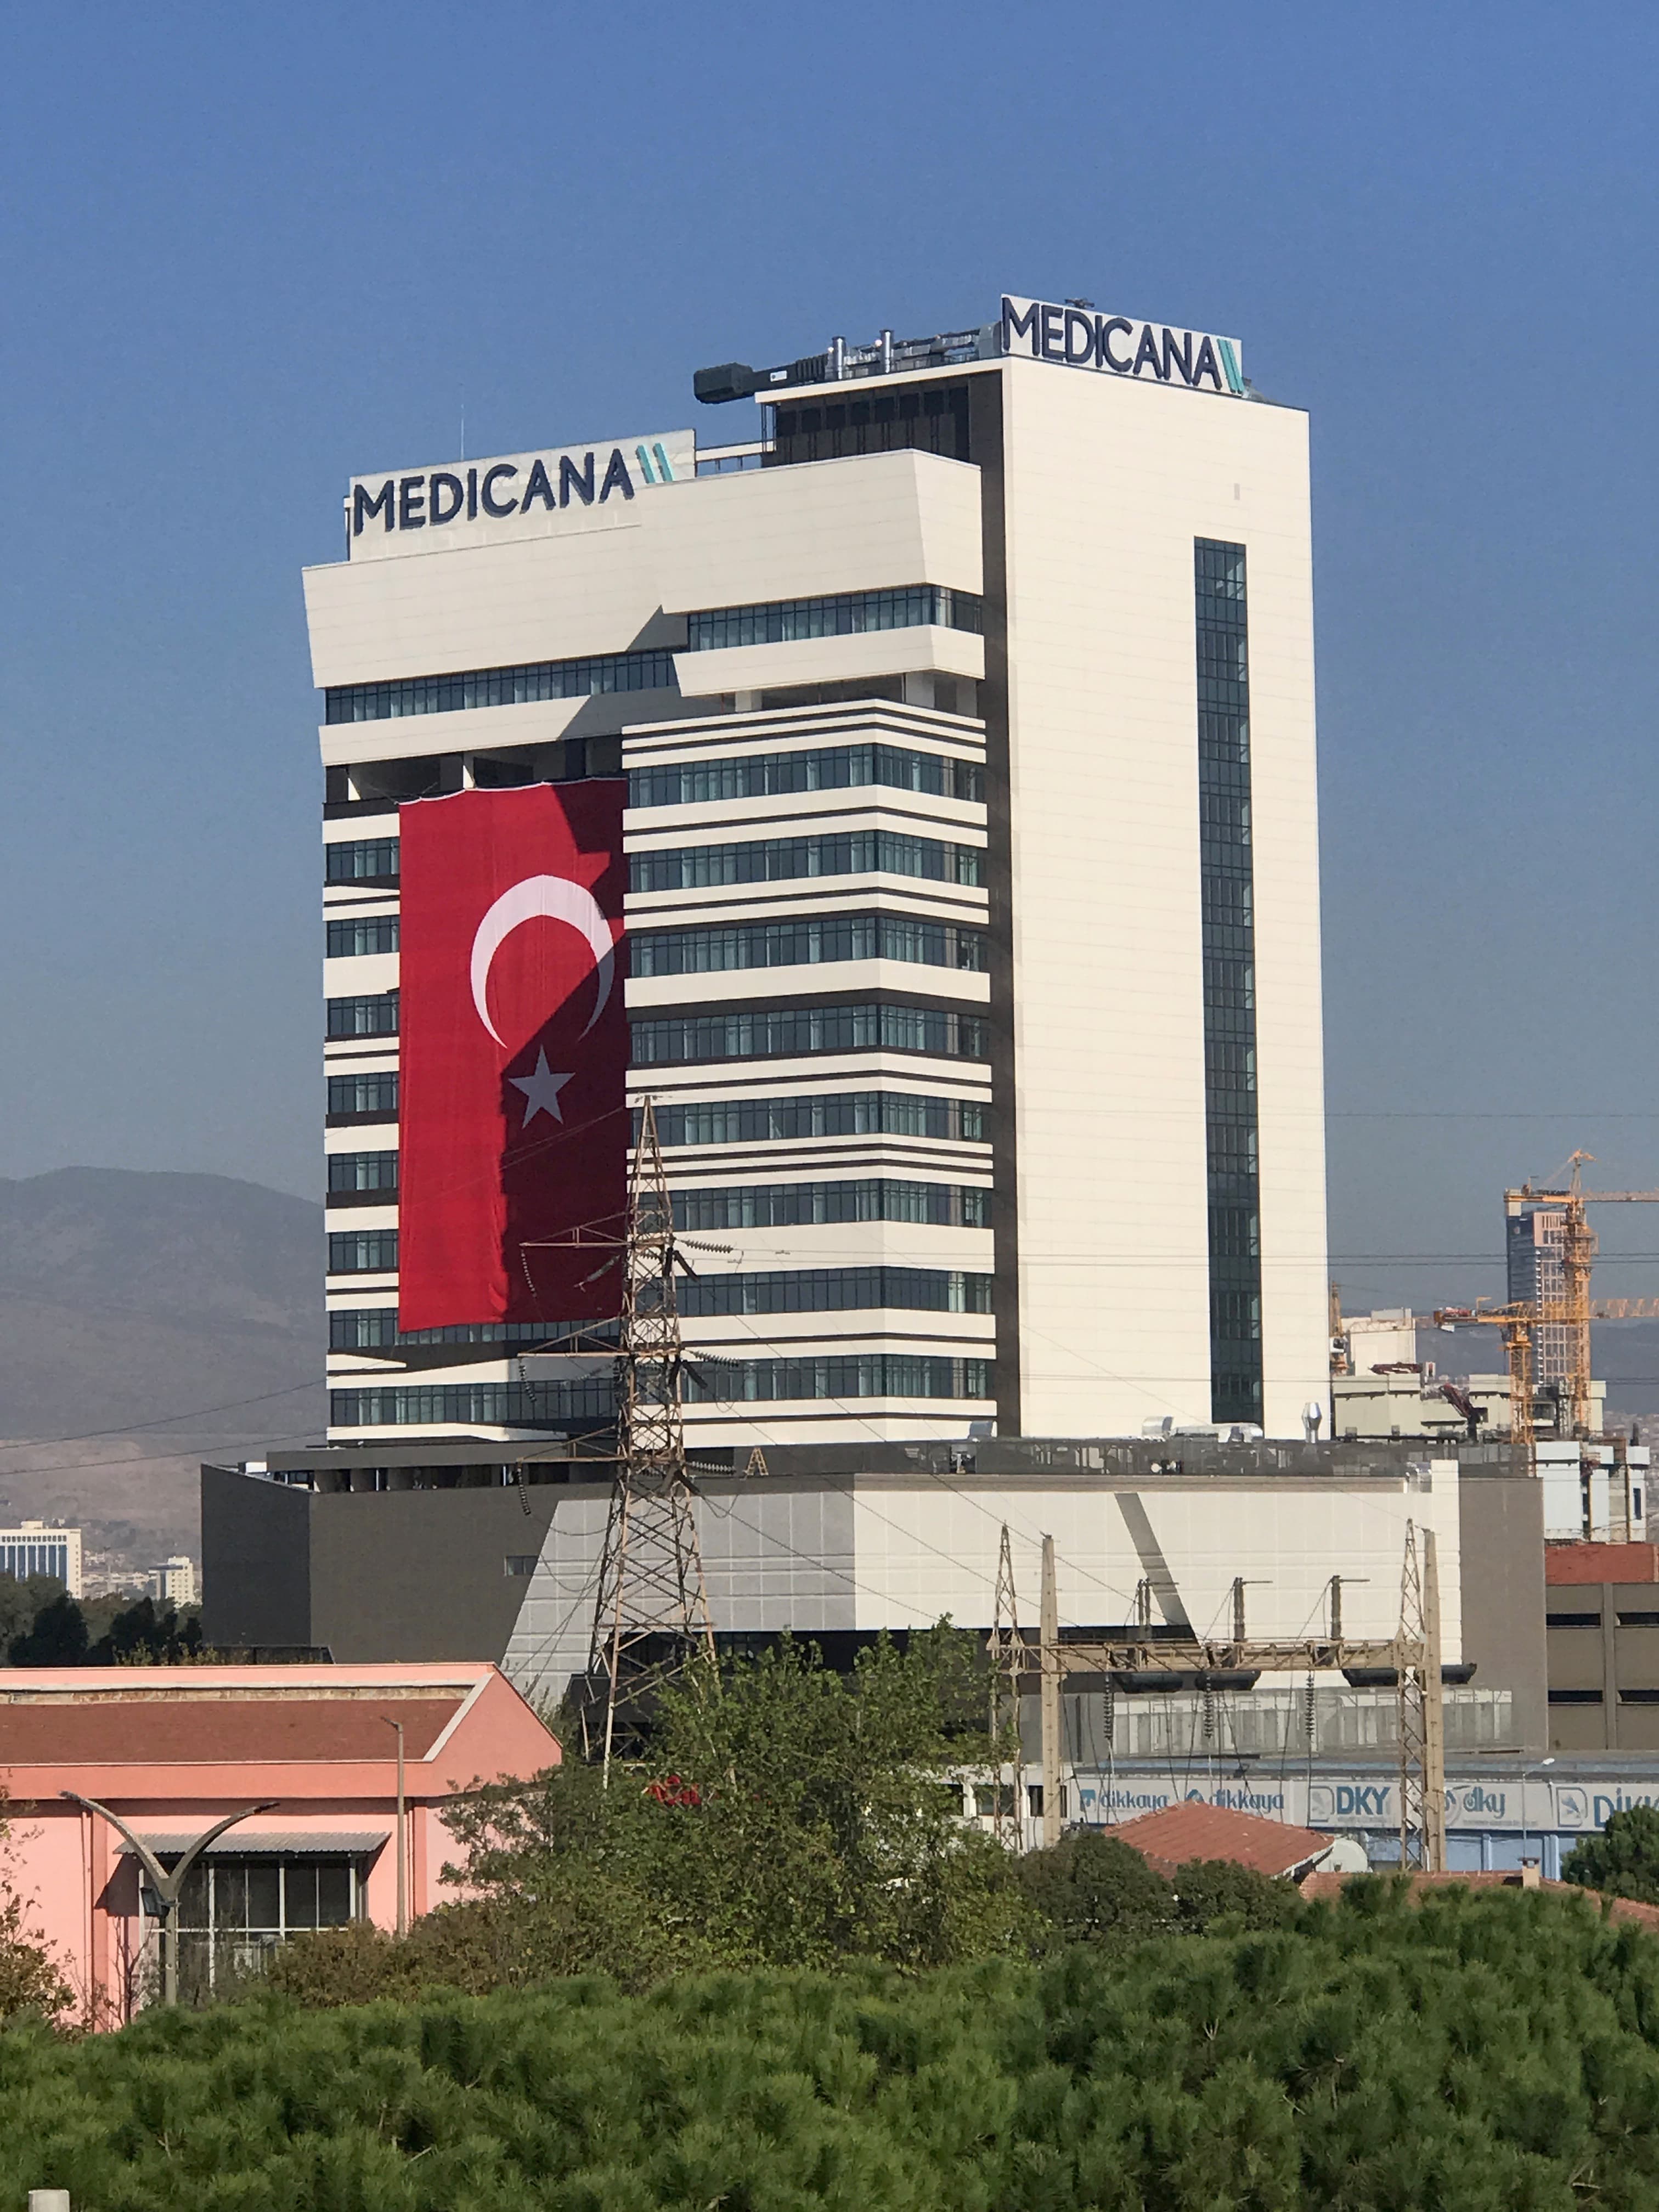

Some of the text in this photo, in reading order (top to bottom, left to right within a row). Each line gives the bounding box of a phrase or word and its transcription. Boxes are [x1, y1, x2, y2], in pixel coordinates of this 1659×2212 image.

[1002, 297, 1223, 391] MEDICANA
[353, 448, 635, 537] MEDICANA
[1336, 1786, 1391, 1815] DKY
[1463, 1786, 1505, 1819] dky
